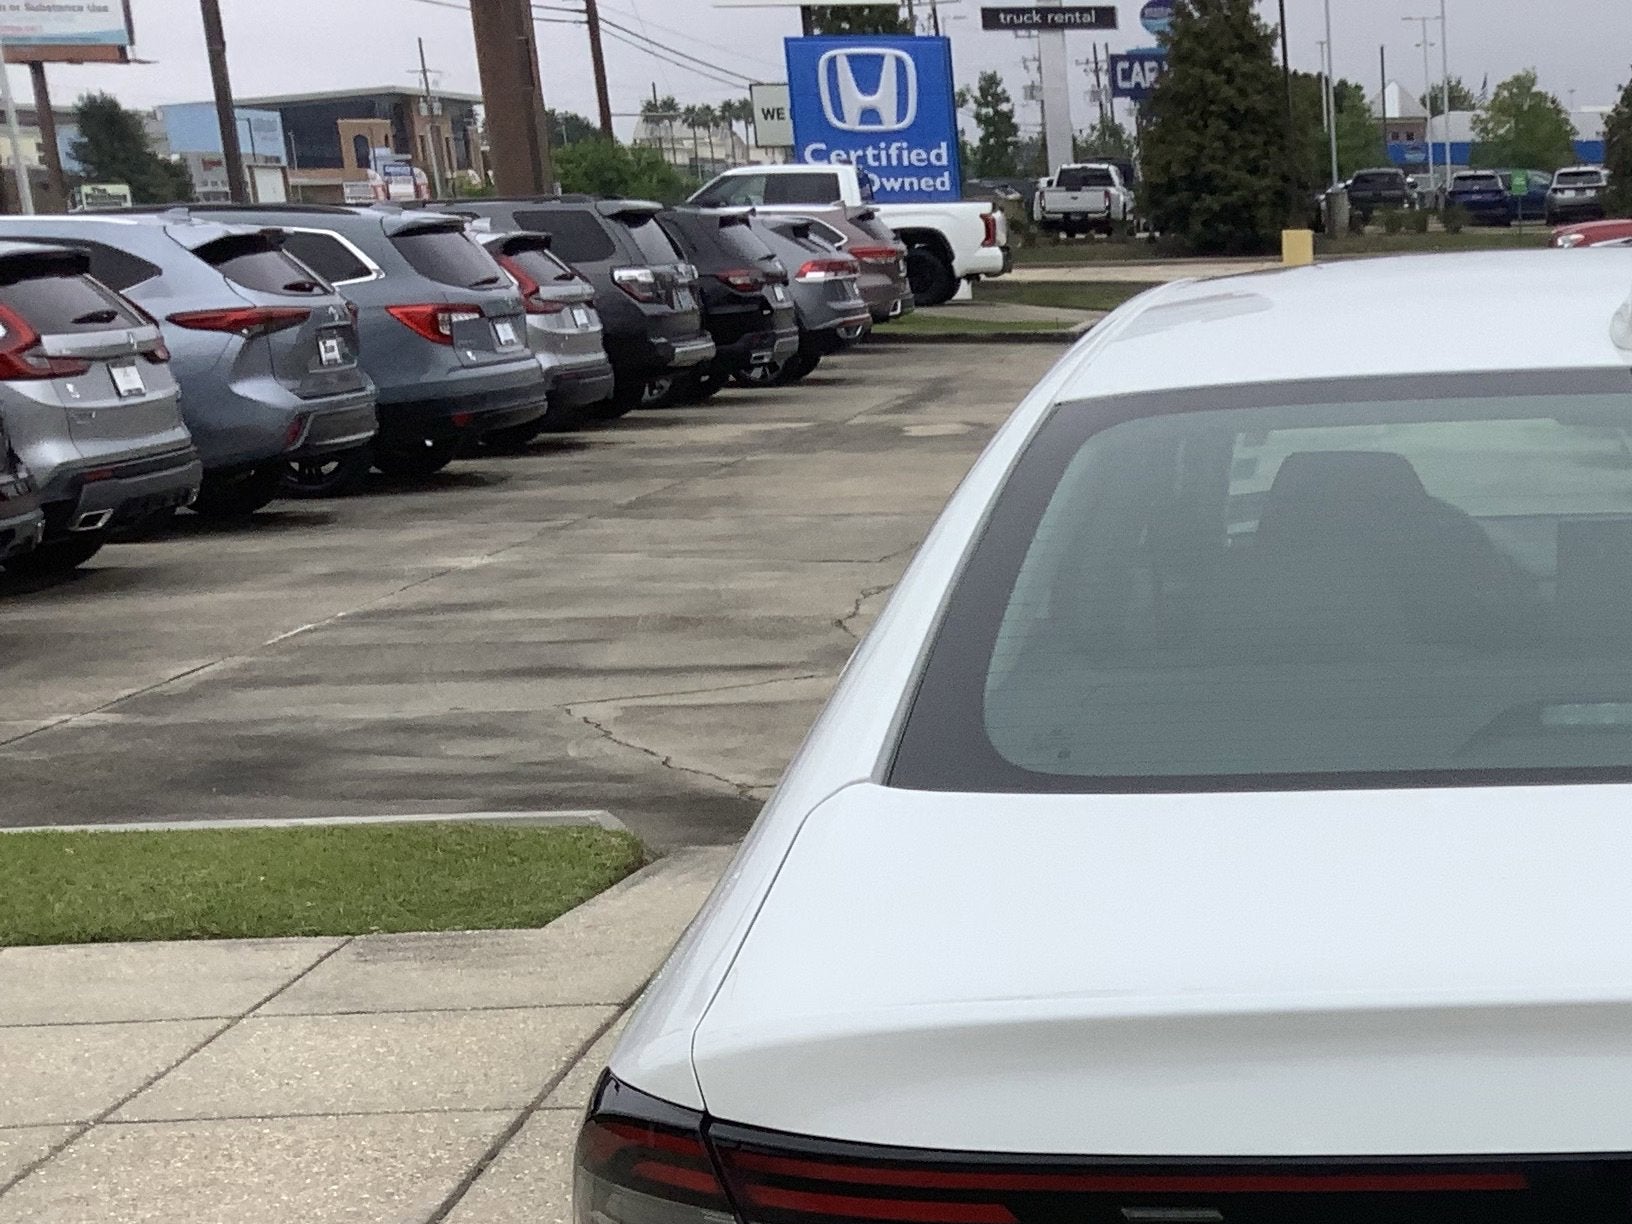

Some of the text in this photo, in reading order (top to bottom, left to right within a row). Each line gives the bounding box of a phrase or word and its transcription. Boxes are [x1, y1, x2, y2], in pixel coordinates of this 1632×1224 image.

[1000, 10, 1096, 24] truck rental
[804, 141, 949, 167] Certified
